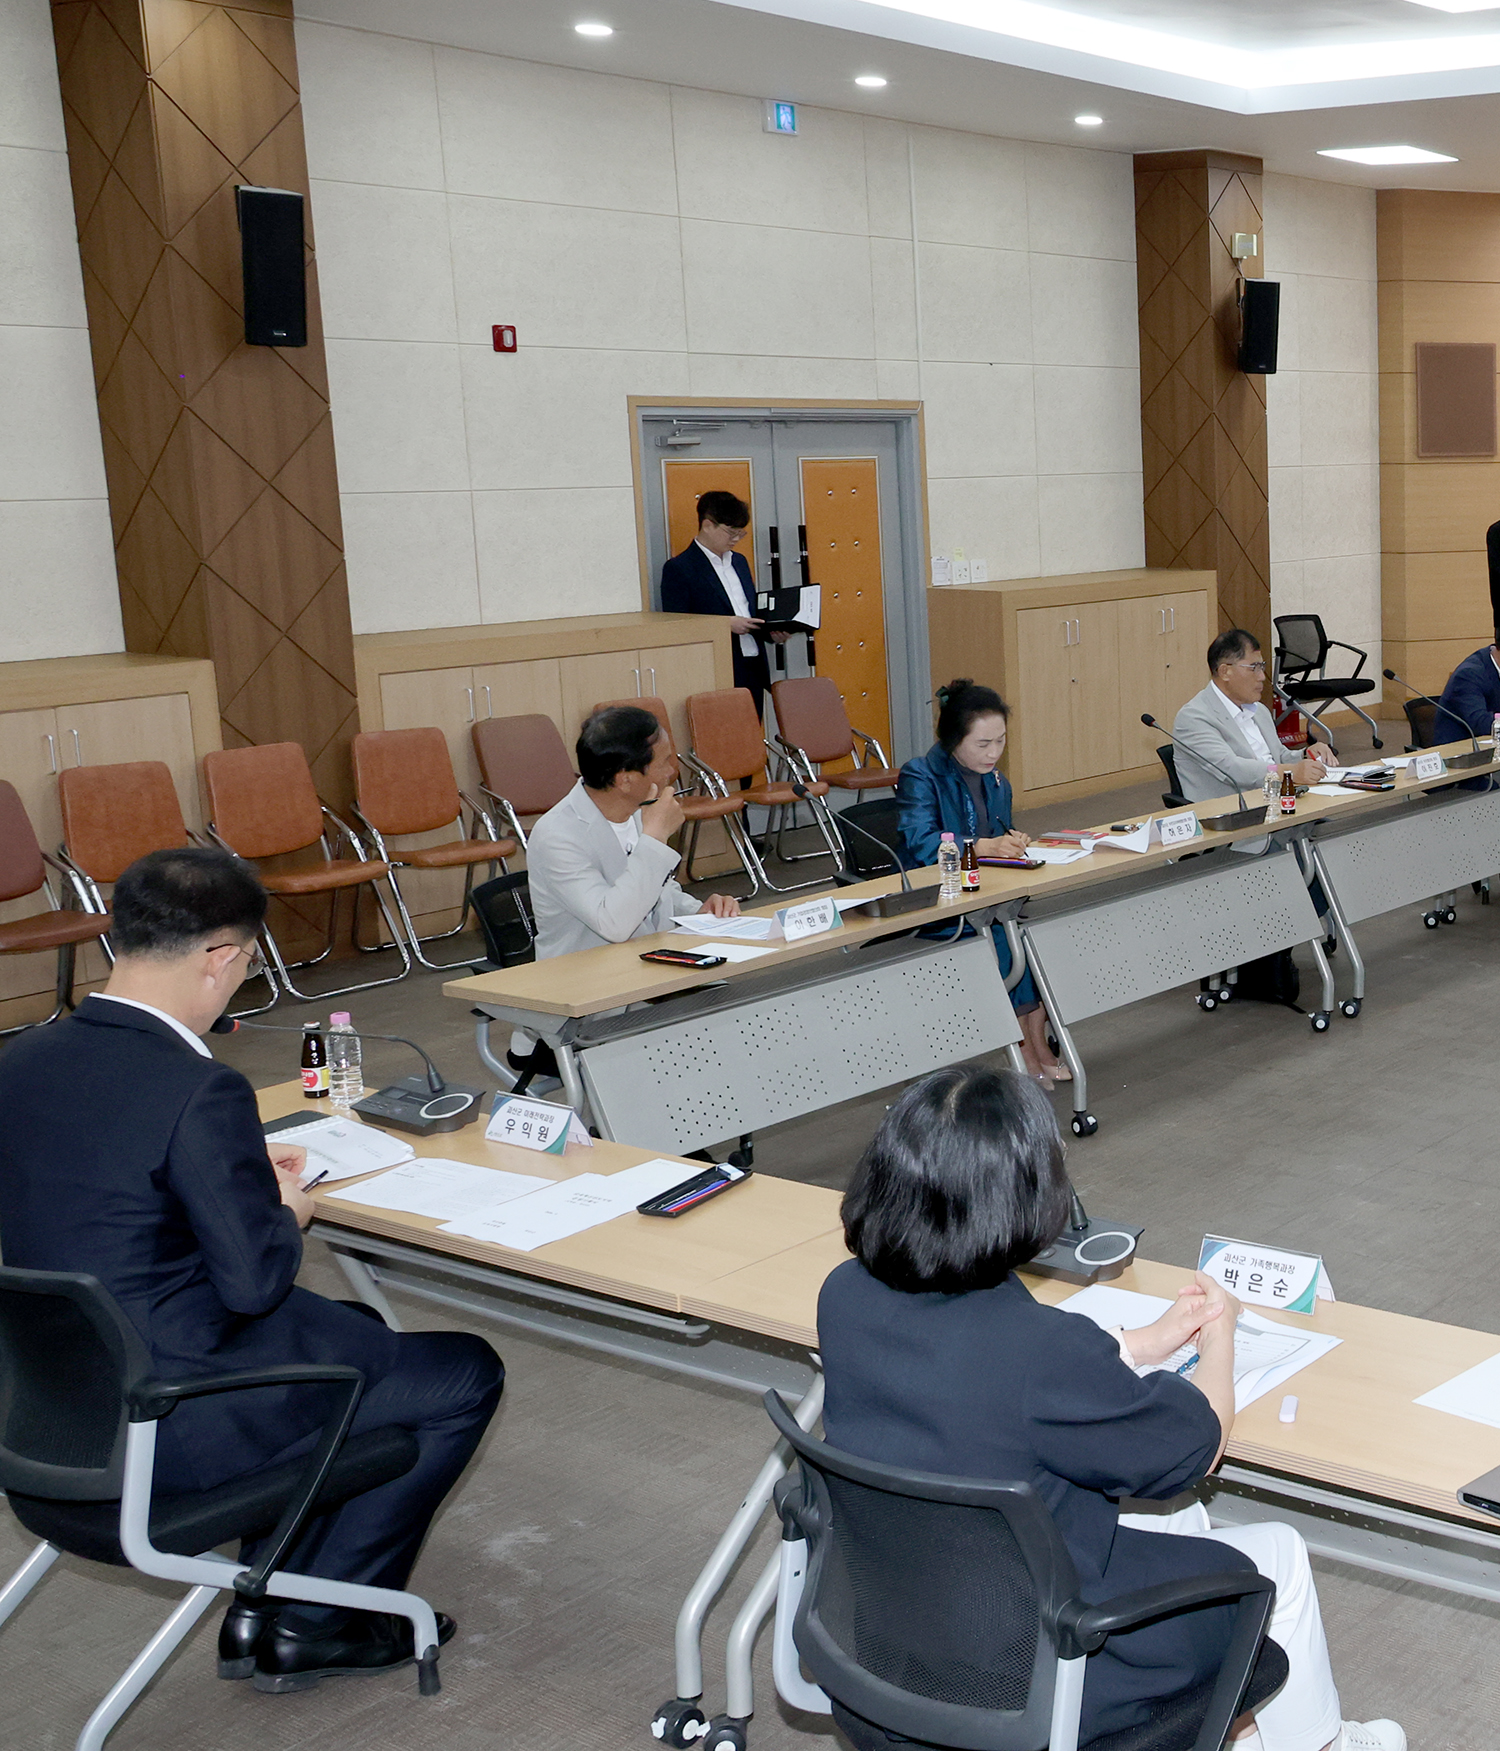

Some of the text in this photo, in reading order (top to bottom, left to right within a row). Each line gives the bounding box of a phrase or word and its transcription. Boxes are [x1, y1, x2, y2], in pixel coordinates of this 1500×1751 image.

[506, 1105, 523, 1117] 괴산군
[1223, 1252, 1296, 1275] 괴산군 가족행복과장
